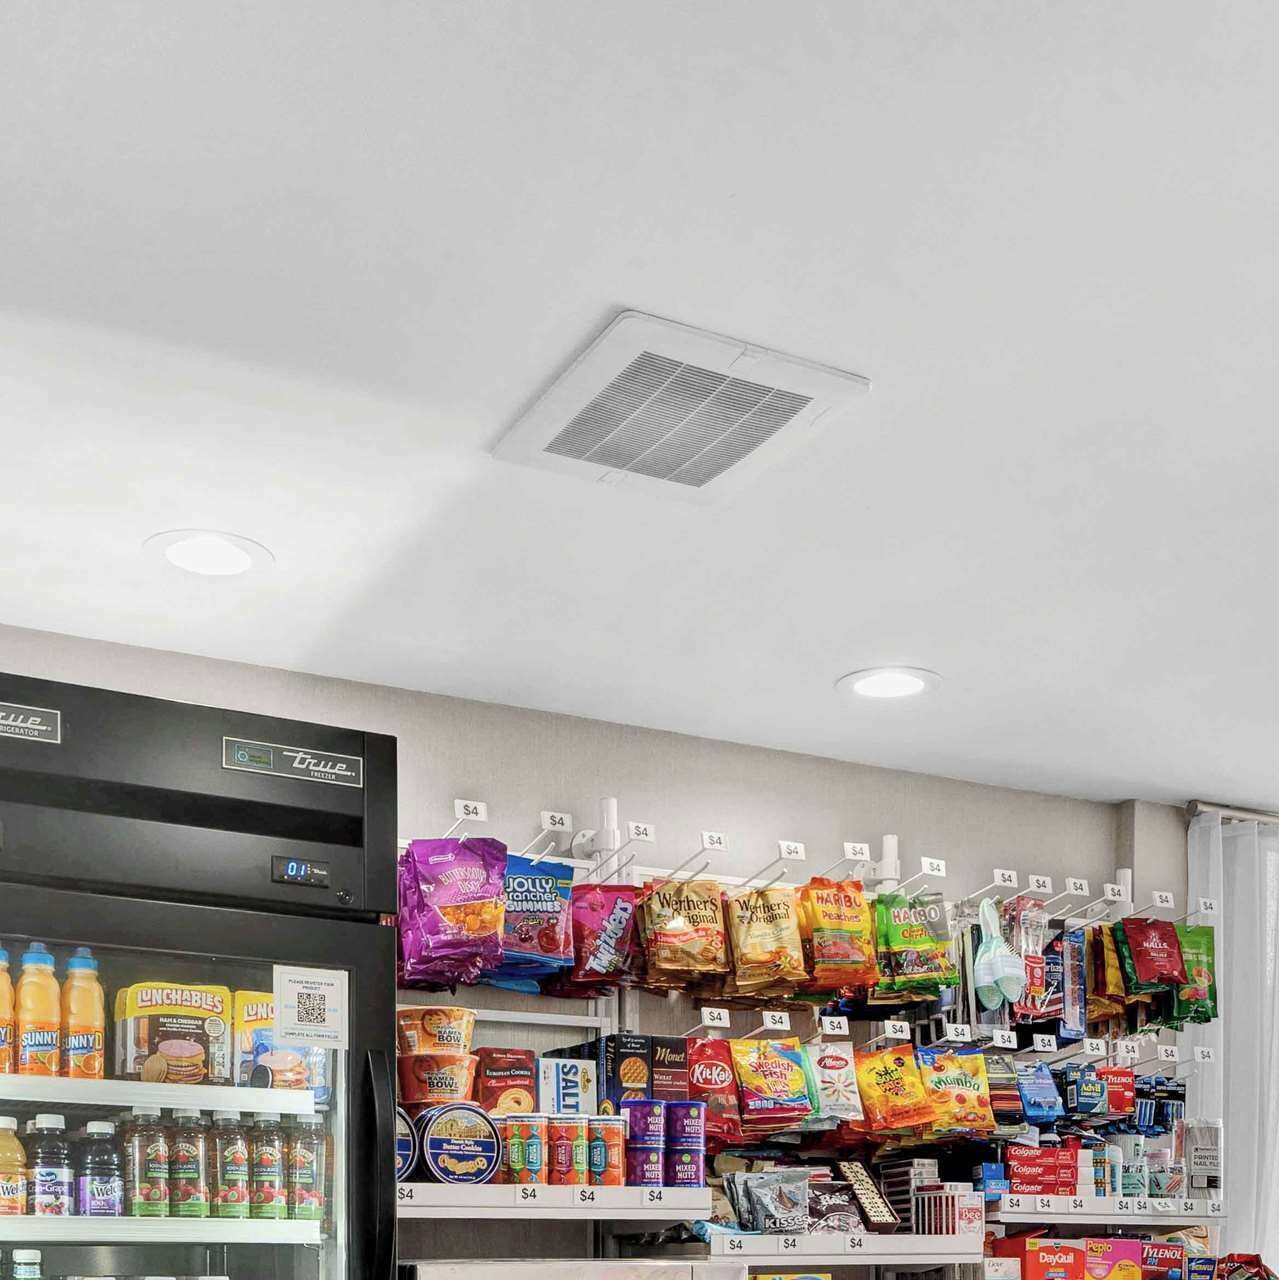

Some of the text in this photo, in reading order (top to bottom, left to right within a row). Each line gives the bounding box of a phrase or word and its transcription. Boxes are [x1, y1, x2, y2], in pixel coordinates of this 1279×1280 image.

[463, 804, 479, 816] $4
[550, 816, 565, 826] $4
[634, 826, 648, 837] $4
[708, 835, 722, 846] $4
[851, 846, 864, 857] $4
[287, 861, 305, 876] 01
[1001, 873, 1012, 883] $4
[506, 877, 554, 892] JOLLY
[1073, 882, 1083, 892] $4
[1158, 895, 1169, 904] $4
[506, 901, 561, 912] GUMMIES
[736, 900, 790, 916] Werther's
[138, 989, 223, 1014] LUNCHABLES
[709, 1011, 722, 1022] $4
[770, 1015, 784, 1025] $4
[830, 1020, 842, 1030] $4
[953, 1027, 965, 1037] $4
[1001, 1034, 1012, 1044] $4
[1090, 1042, 1100, 1052] $4
[656, 1046, 685, 1062] Monet
[1164, 1048, 1174, 1058] $4
[1107, 1075, 1133, 1084] TYLENOL
[561, 1063, 579, 1112] SALT
[1080, 1083, 1100, 1092] Advil
[1011, 1147, 1041, 1156] Colgate
[676, 1164, 696, 1173] MIXED
[677, 1171, 695, 1179] NUTS
[398, 1188, 414, 1199] $4
[521, 1188, 536, 1199] $4
[649, 1191, 662, 1201] $4
[1009, 1199, 1020, 1208] $4
[1072, 1199, 1083, 1209] $4
[1118, 1201, 1129, 1210] $4
[1184, 1202, 1194, 1211] $4
[730, 1240, 742, 1250] $4
[1087, 1241, 1112, 1253] Pepto
[1143, 1246, 1182, 1258] TYLENOL
[1039, 1252, 1074, 1265] DayQuil
